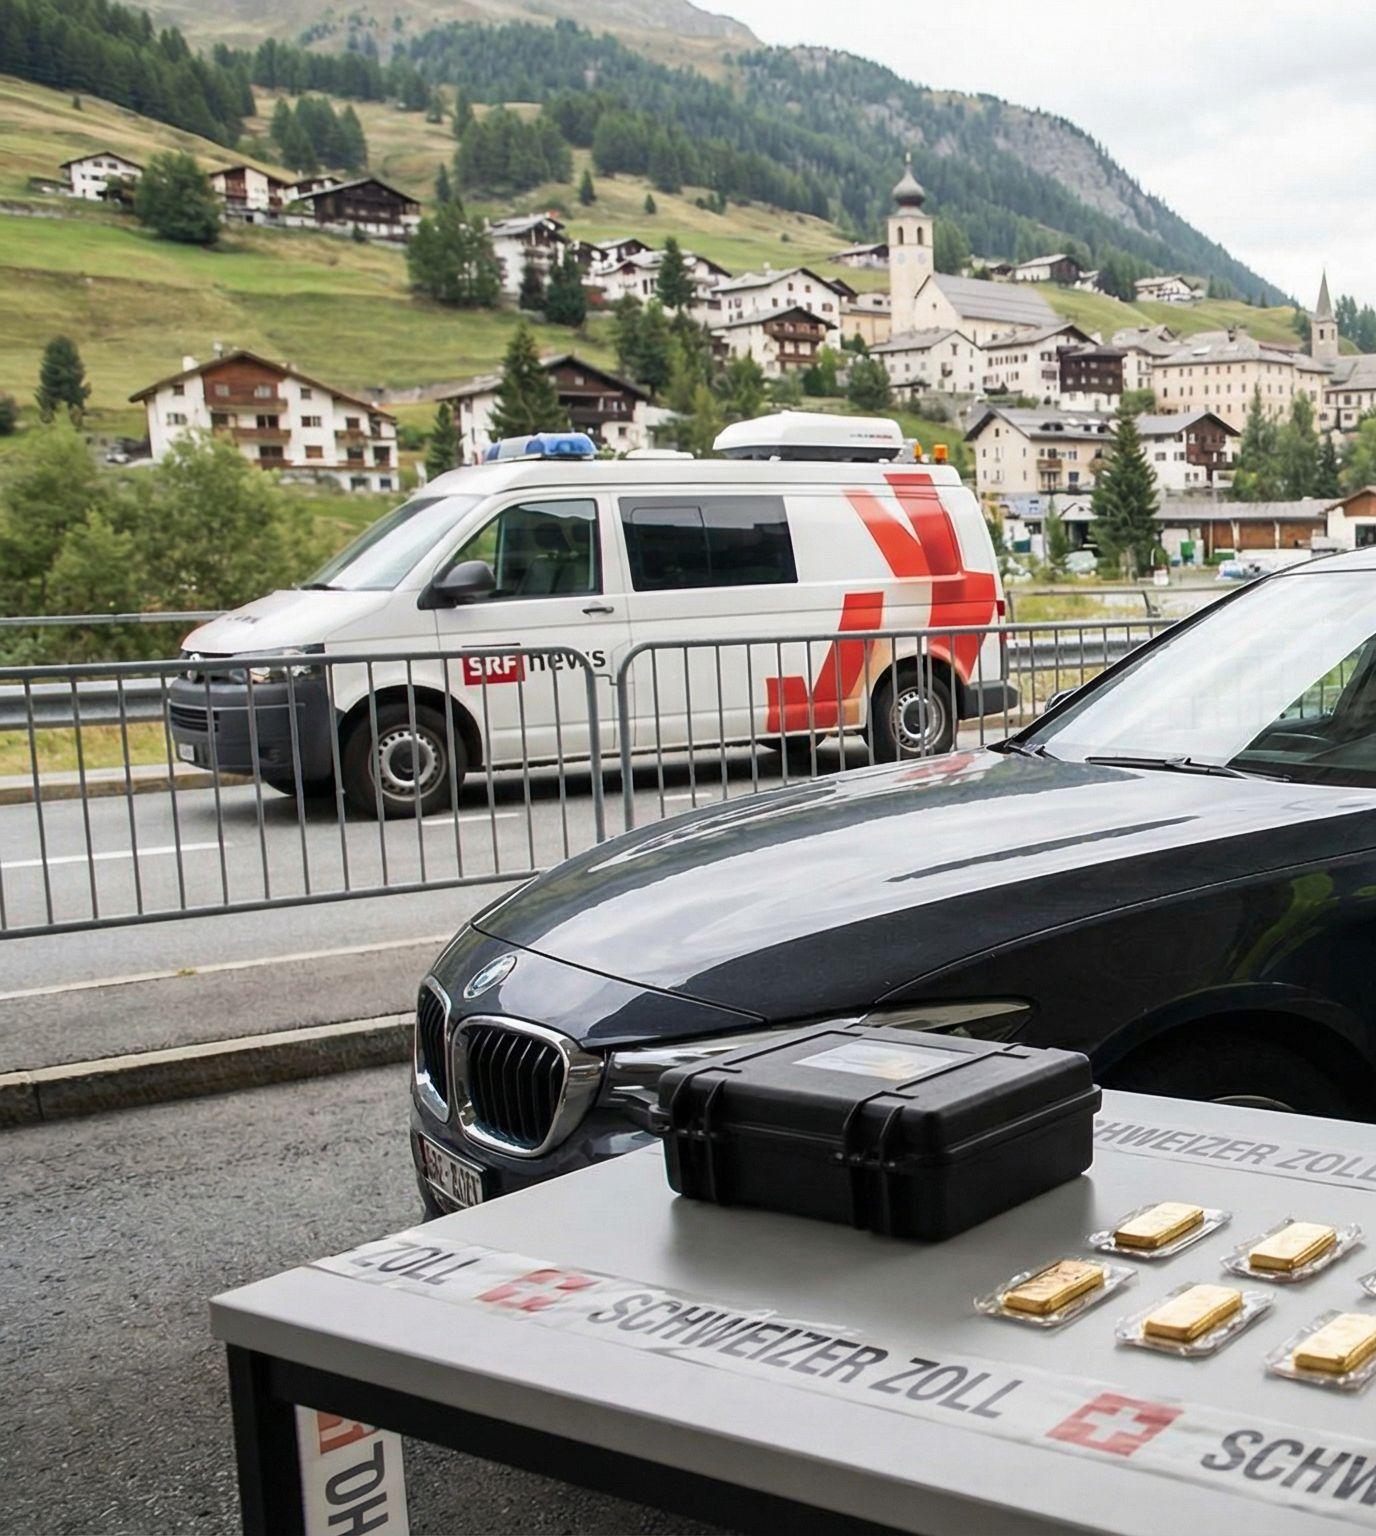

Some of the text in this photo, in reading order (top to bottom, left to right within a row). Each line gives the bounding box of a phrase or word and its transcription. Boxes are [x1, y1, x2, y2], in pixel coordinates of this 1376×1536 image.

[468, 654, 517, 677] SRF
[1095, 1120, 1281, 1165] HWEIZER
[350, 1241, 481, 1285] ZOLL
[587, 1293, 1023, 1420] SCHWEIZER ZOLL
